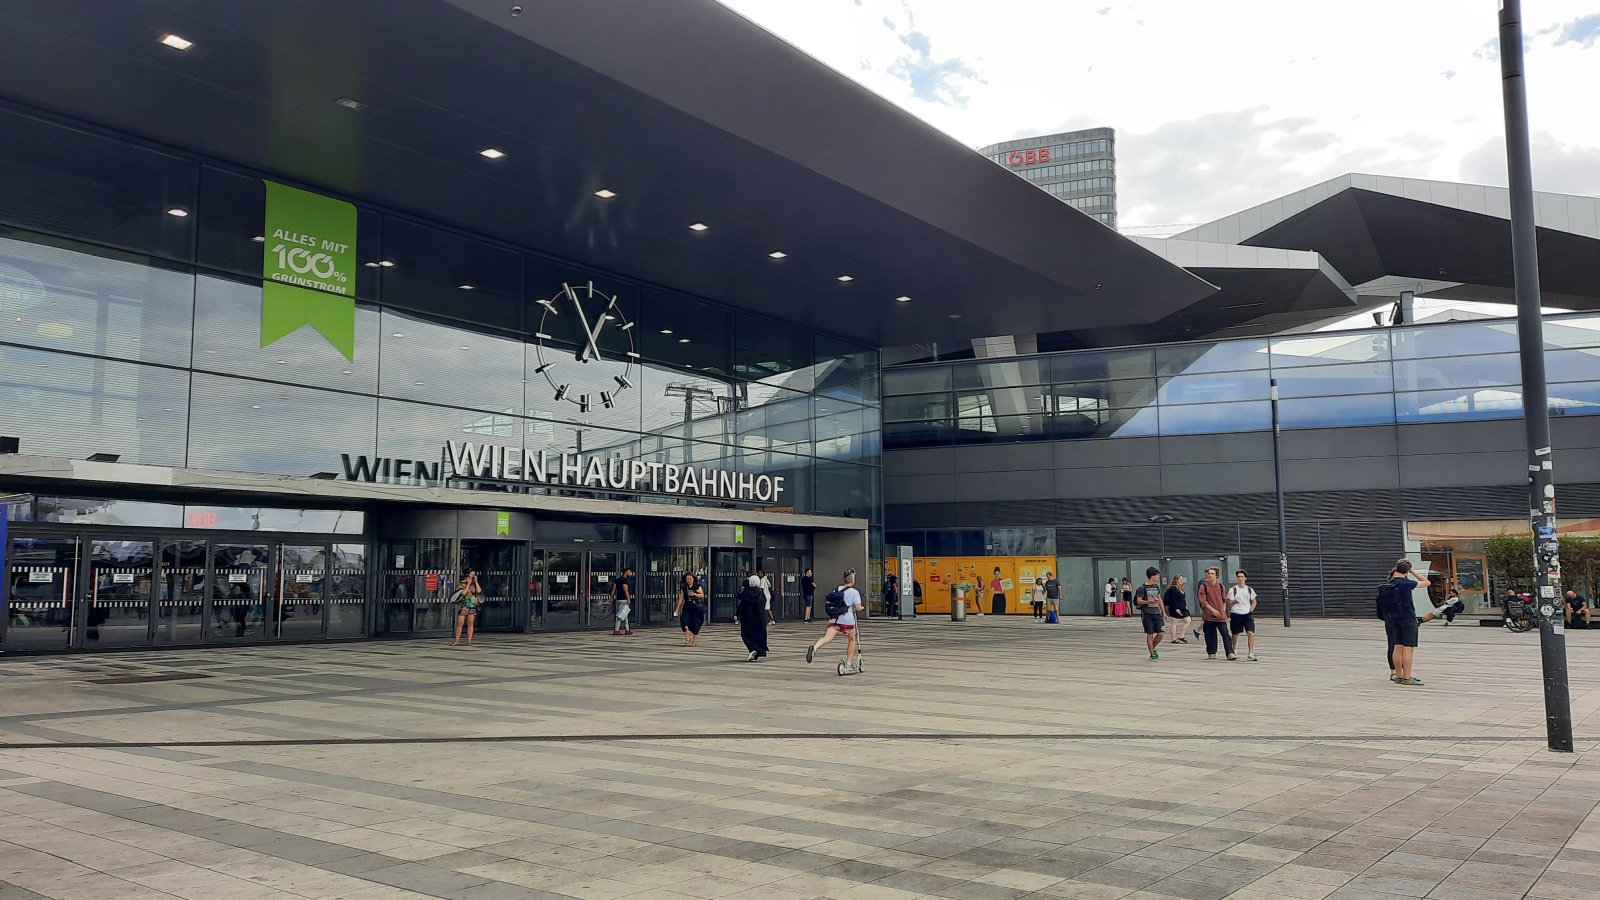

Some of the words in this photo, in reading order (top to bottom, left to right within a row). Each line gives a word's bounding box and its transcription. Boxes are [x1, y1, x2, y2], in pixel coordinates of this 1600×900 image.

[1009, 148, 1050, 166] ÖBB
[272, 228, 317, 247] ALLES
[321, 239, 349, 254] MIT
[271, 243, 347, 283] 100%
[271, 272, 346, 295] GRÜNSTROM
[449, 439, 547, 483] WIEN
[560, 452, 785, 503] HAUPTBAHNHOF
